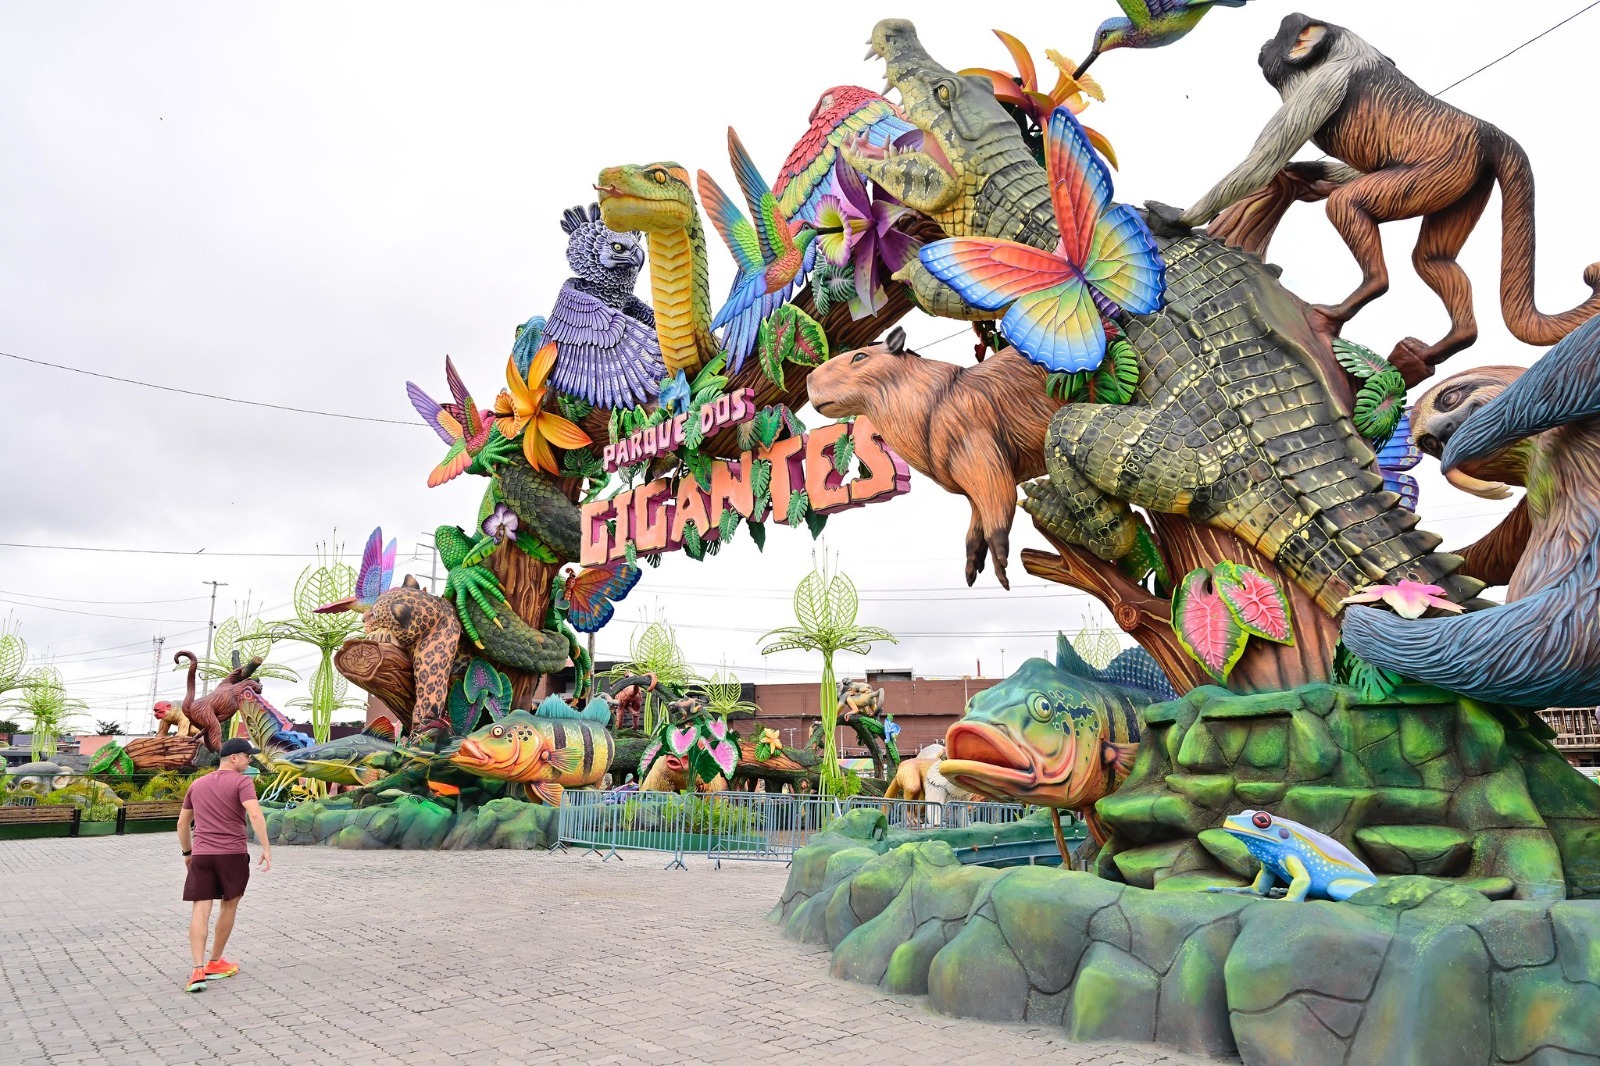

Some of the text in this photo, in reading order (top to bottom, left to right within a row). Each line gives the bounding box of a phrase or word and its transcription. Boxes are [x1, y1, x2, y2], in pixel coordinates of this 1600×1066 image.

[603, 387, 755, 472] PARQUE DOS
[580, 414, 908, 568] GIGANTES
